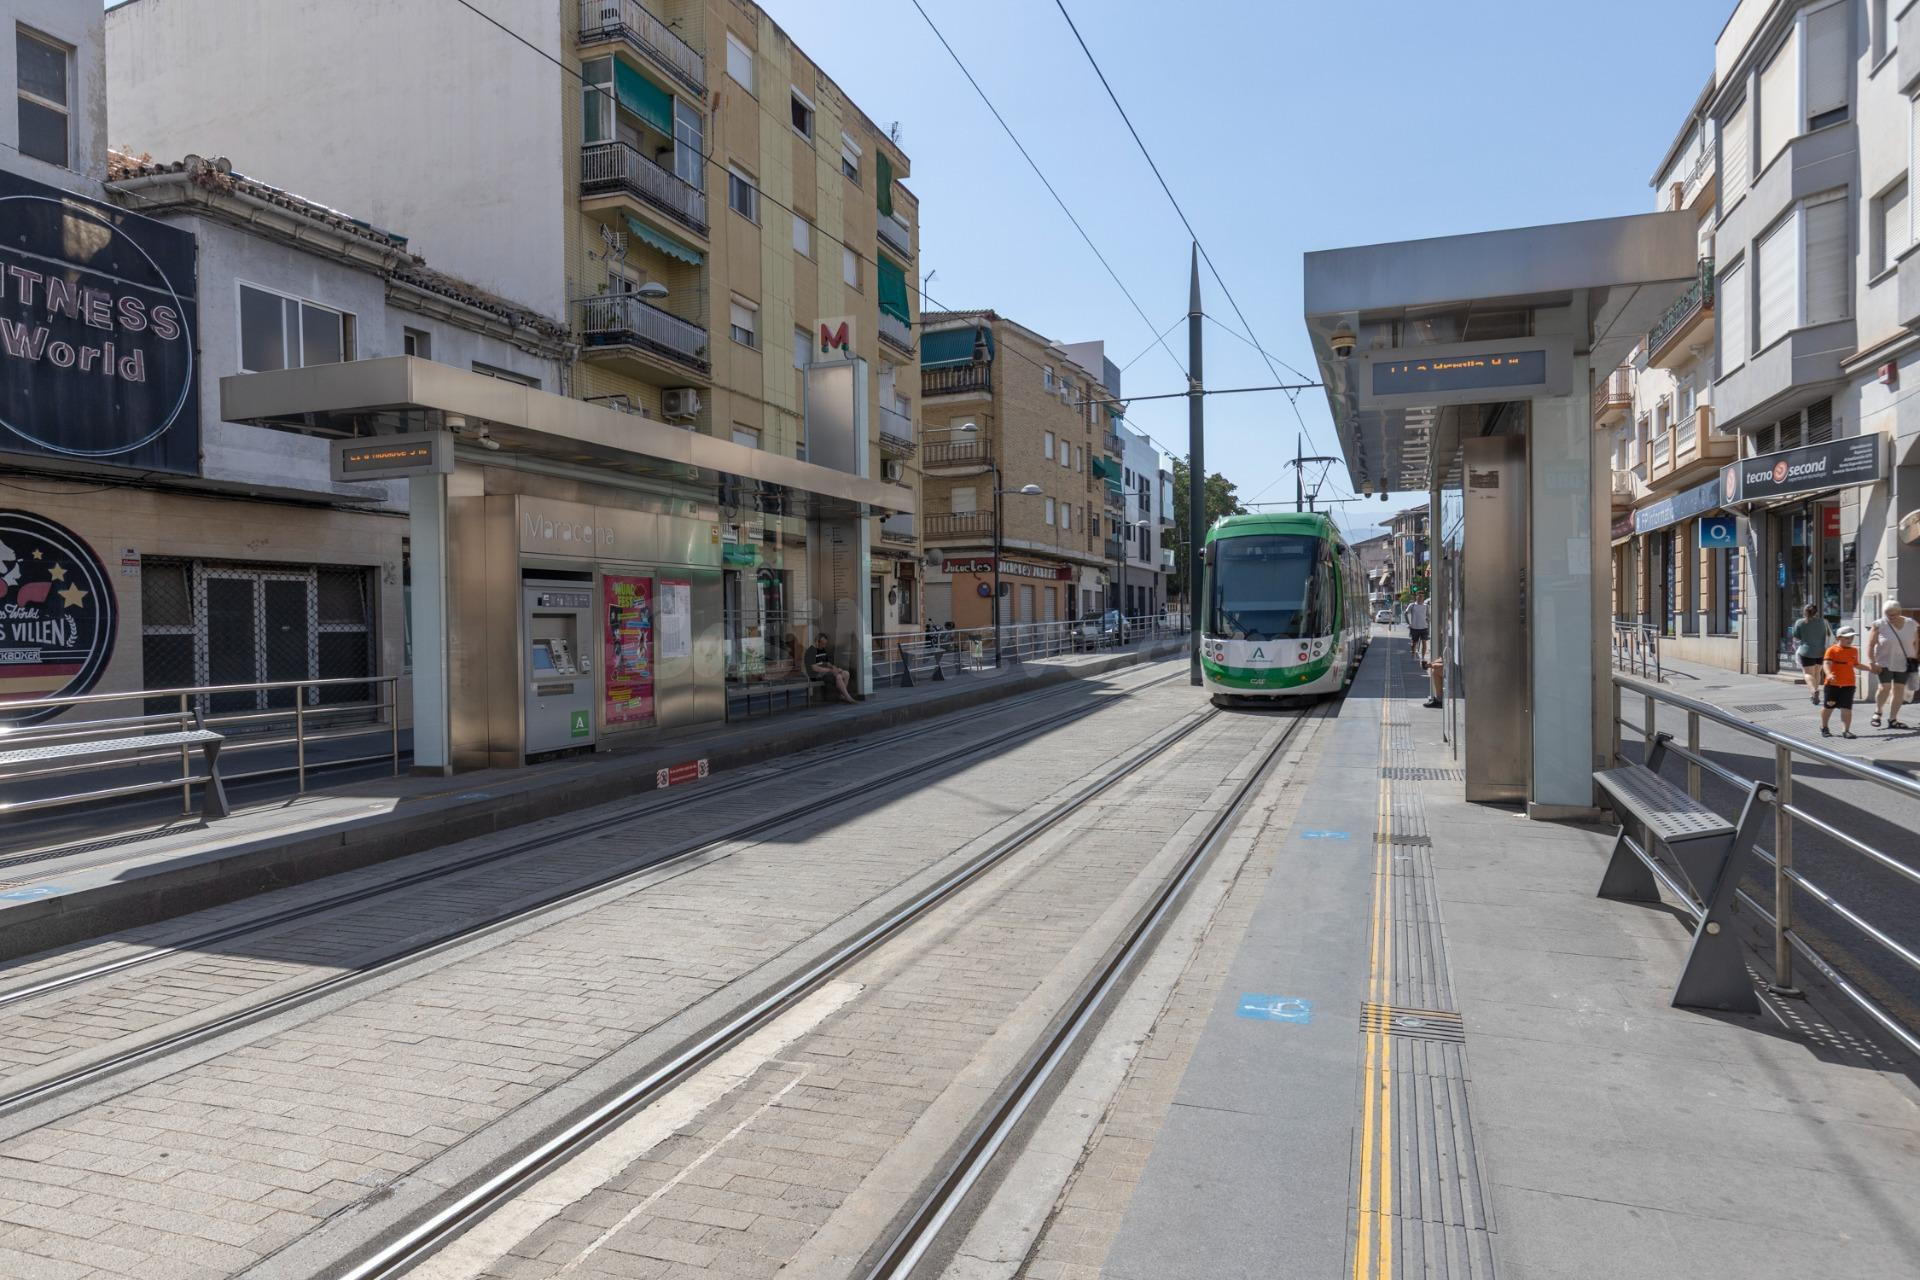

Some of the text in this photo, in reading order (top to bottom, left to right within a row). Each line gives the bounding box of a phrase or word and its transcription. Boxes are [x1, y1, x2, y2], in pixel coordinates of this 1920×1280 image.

[0, 316, 146, 383] World
[820, 321, 849, 353] M
[1746, 470, 1772, 485] tecno
[1787, 456, 1827, 477] second
[524, 511, 616, 545] Maracena
[11, 618, 65, 647] VILLEN
